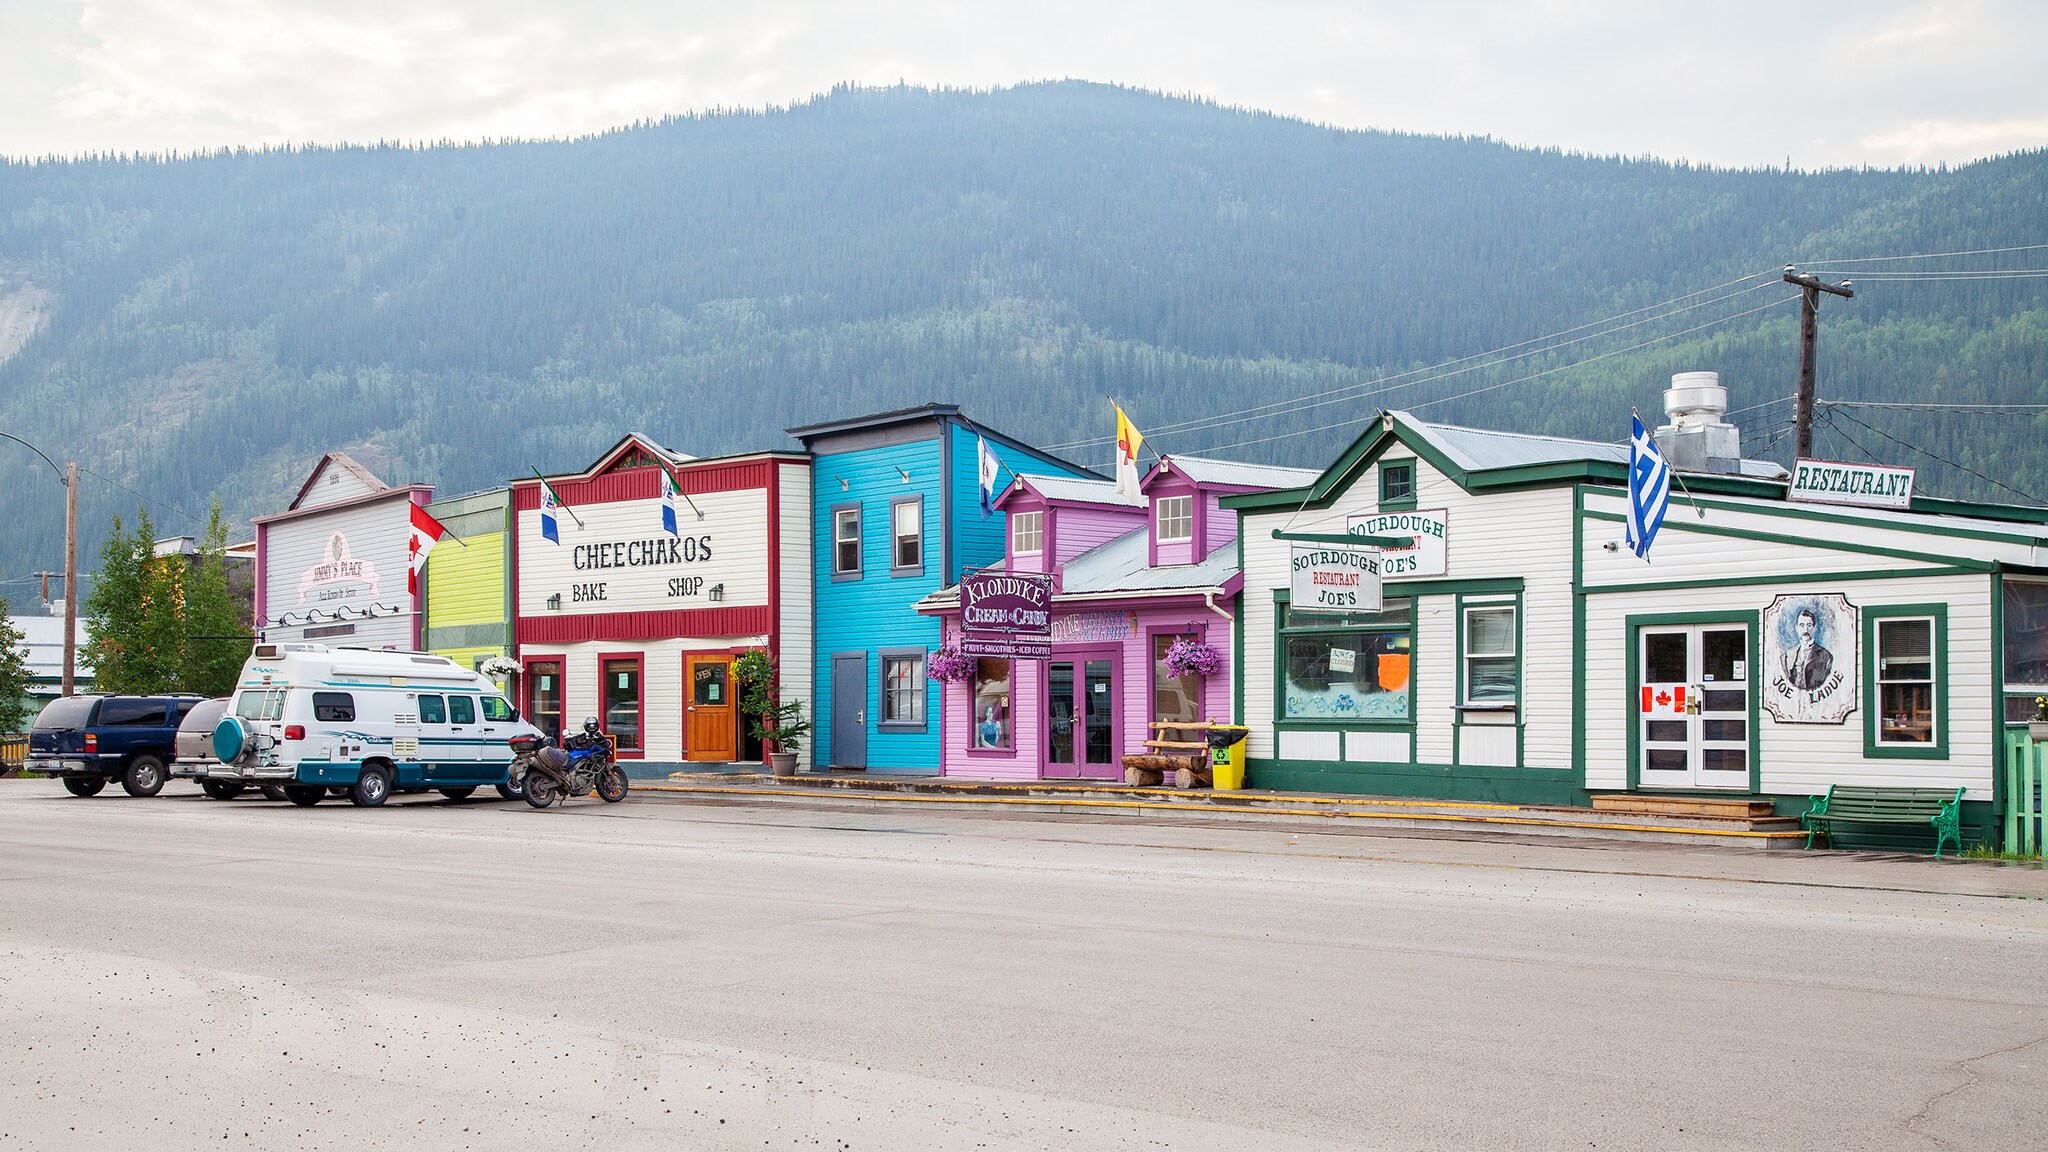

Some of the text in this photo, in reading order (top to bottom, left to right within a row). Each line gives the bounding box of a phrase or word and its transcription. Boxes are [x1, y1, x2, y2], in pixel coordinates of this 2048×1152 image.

[1795, 466, 1910, 497] RESTAURANT
[574, 535, 712, 570] CHEECHAKOS
[341, 561, 363, 577] PLACE
[1293, 551, 1379, 576] SOURDOUGH
[1381, 555, 1417, 574] OE'S
[572, 576, 704, 602] BAKE SHOP
[1313, 572, 1360, 586] RESTAURANT
[966, 578, 1044, 607] KLONDYKE
[1318, 590, 1356, 605] JOE'S
[964, 606, 1008, 623] CREAM
[1013, 607, 1050, 627] CANDY
[1082, 610, 1125, 630] CREAM
[1032, 646, 1051, 655] COFFEE
[695, 668, 712, 681] OPEN
[1772, 670, 1845, 704] JOE LADUE
